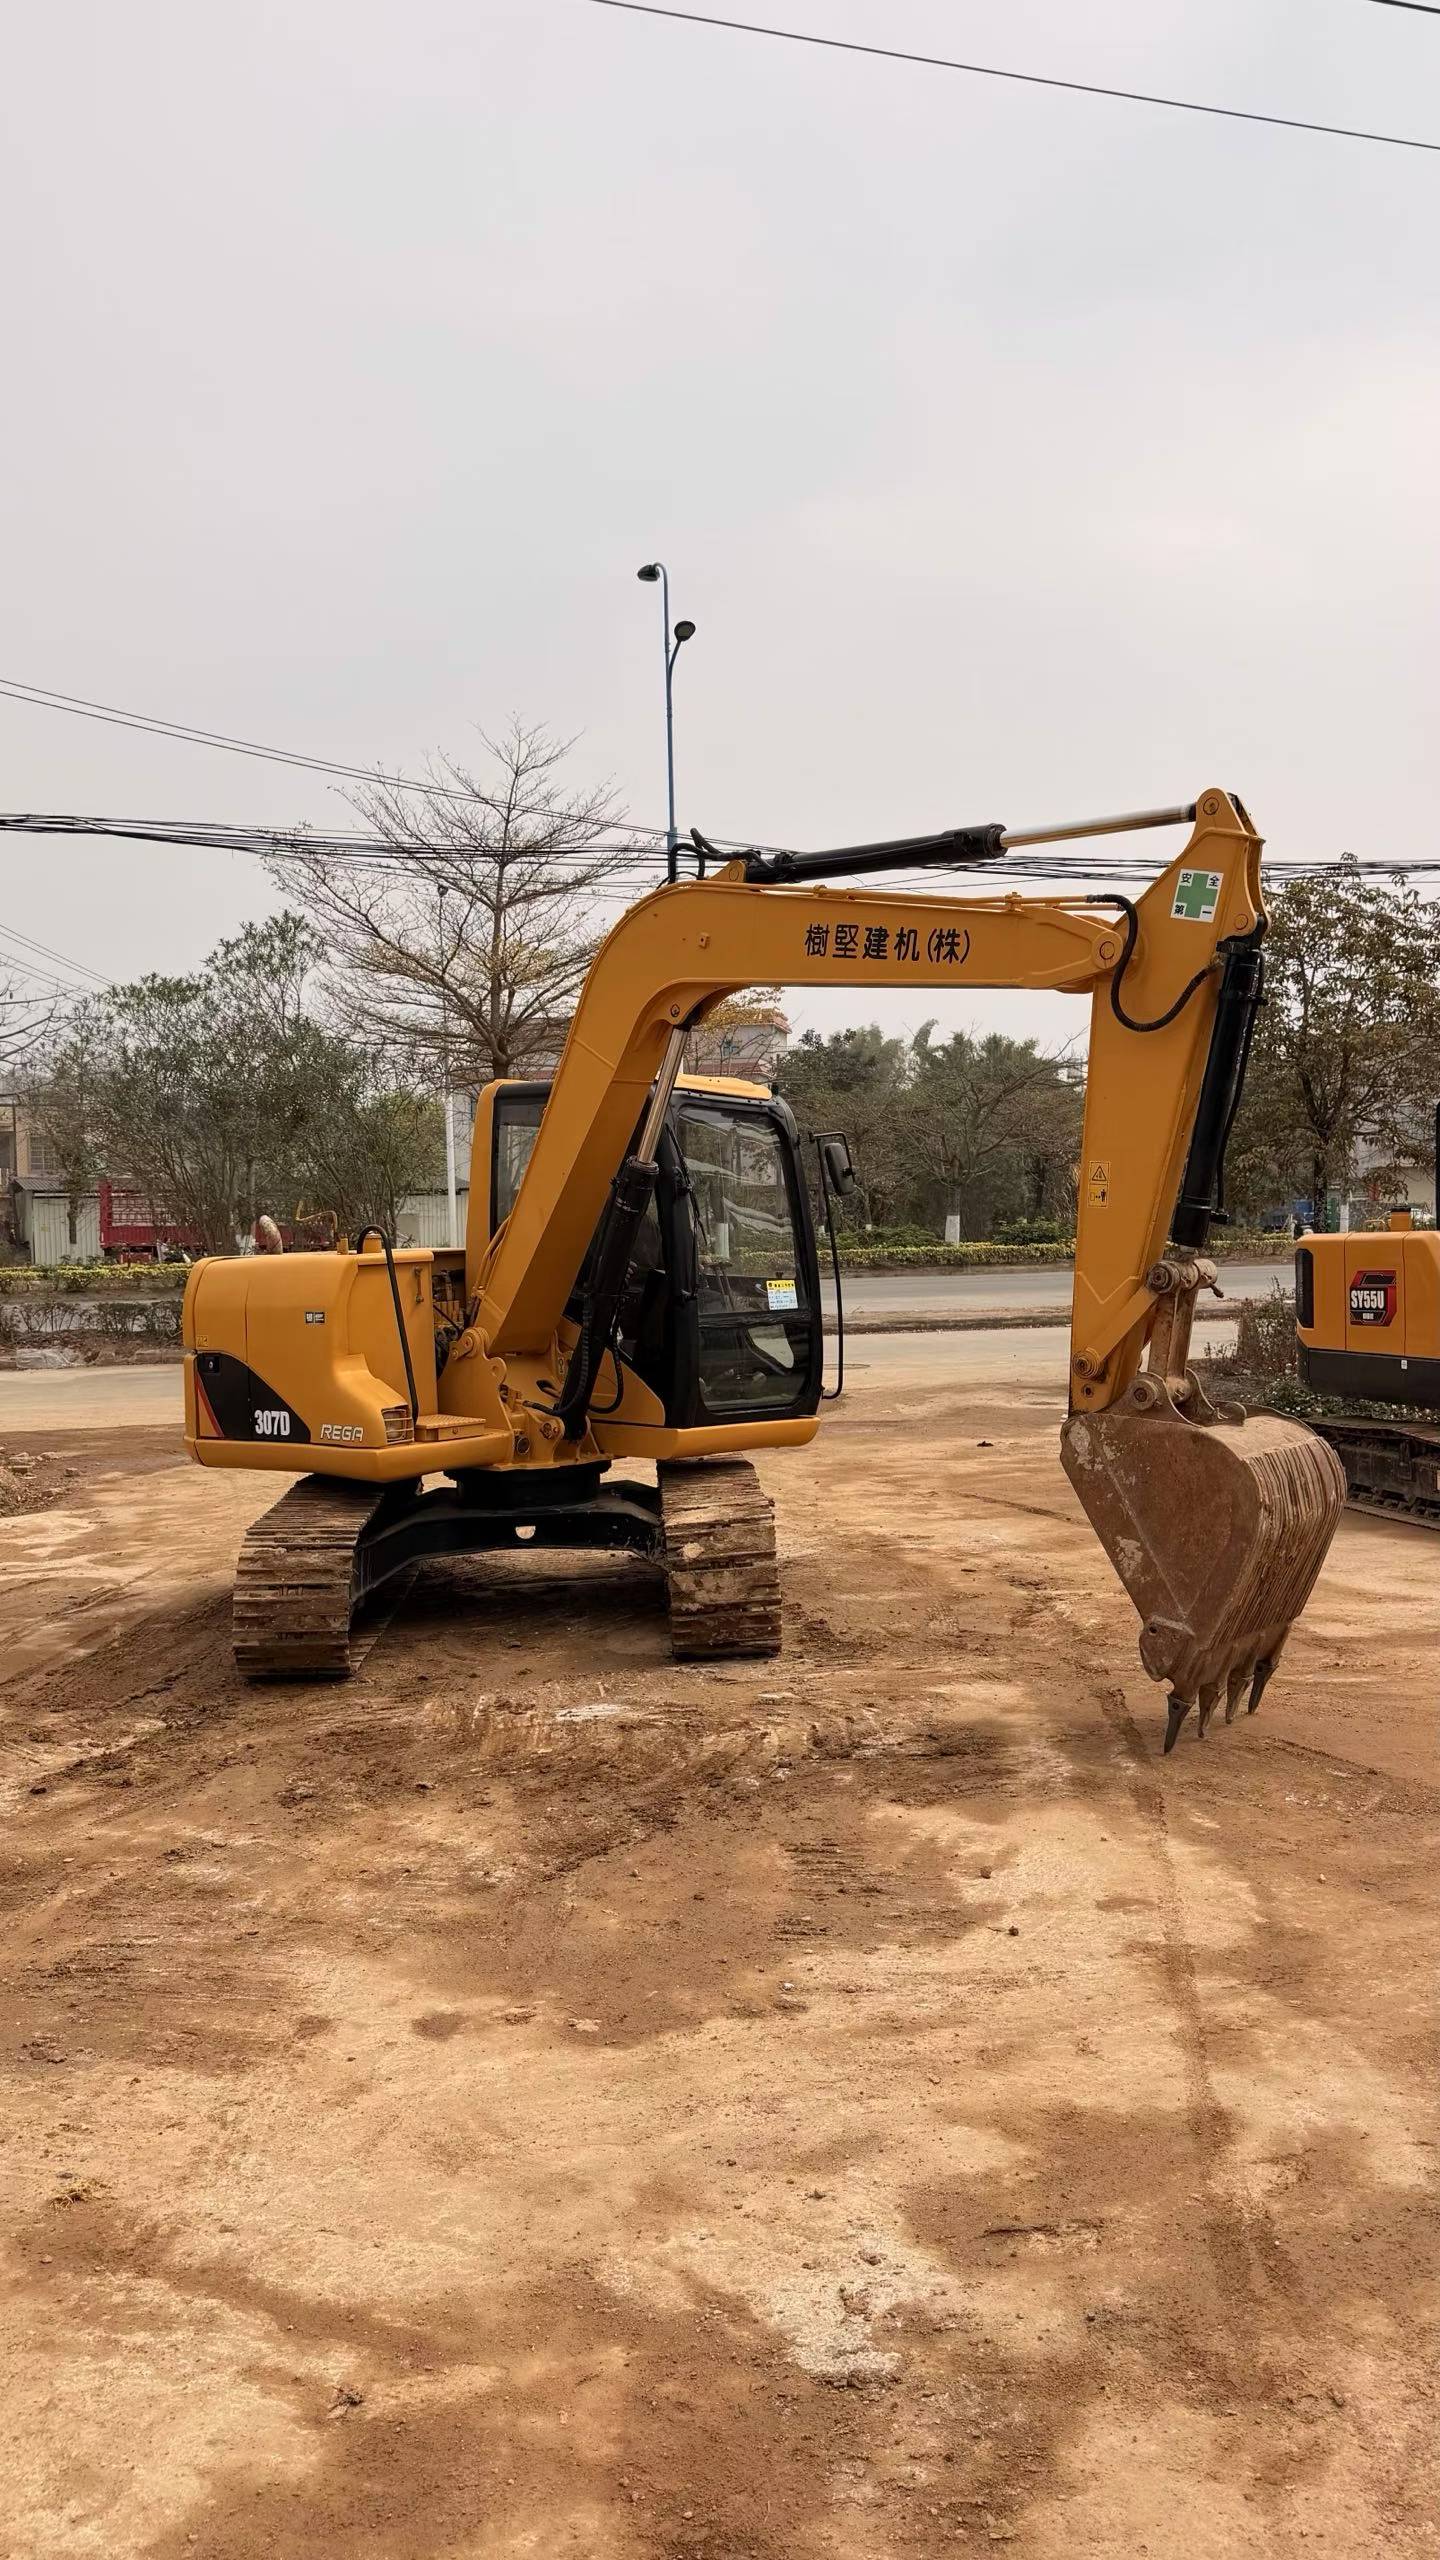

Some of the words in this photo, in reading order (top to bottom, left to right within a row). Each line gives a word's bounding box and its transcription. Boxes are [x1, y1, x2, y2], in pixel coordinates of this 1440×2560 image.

[1181, 872, 1219, 887] 安全
[1351, 1290, 1384, 1309] SY55U
[254, 1410, 291, 1437] 307D
[320, 1424, 364, 1442] REGA
